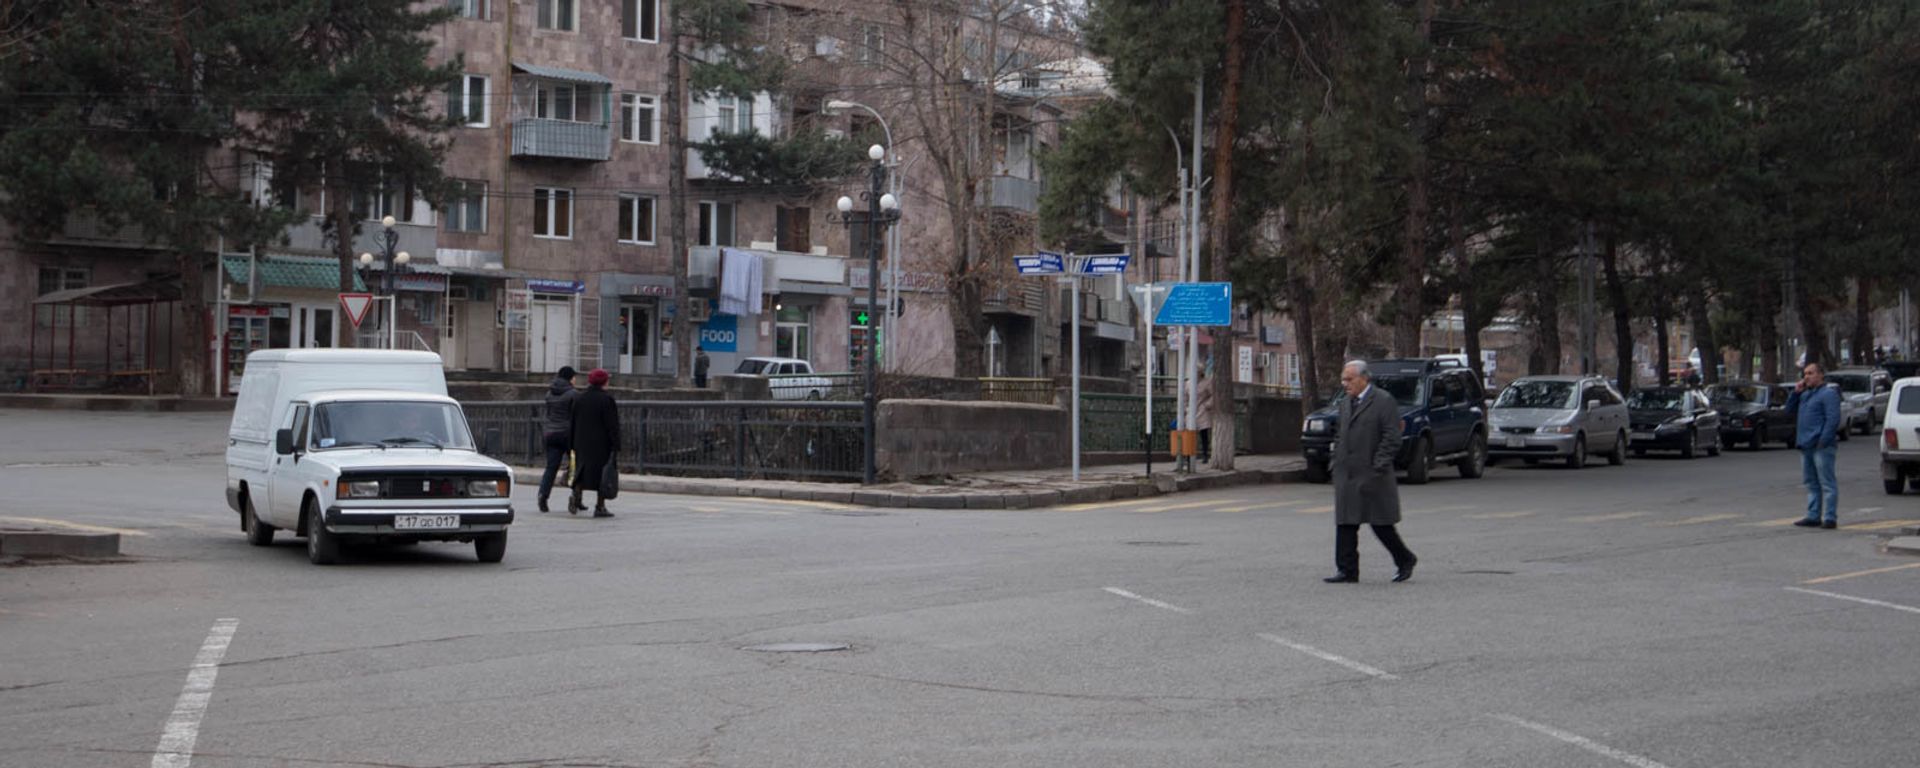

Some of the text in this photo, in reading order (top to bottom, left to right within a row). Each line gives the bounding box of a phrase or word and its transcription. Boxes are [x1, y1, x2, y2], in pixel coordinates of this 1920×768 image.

[701, 329, 735, 343] FOOD
[406, 516, 418, 527] 17
[436, 516, 456, 527] 017
